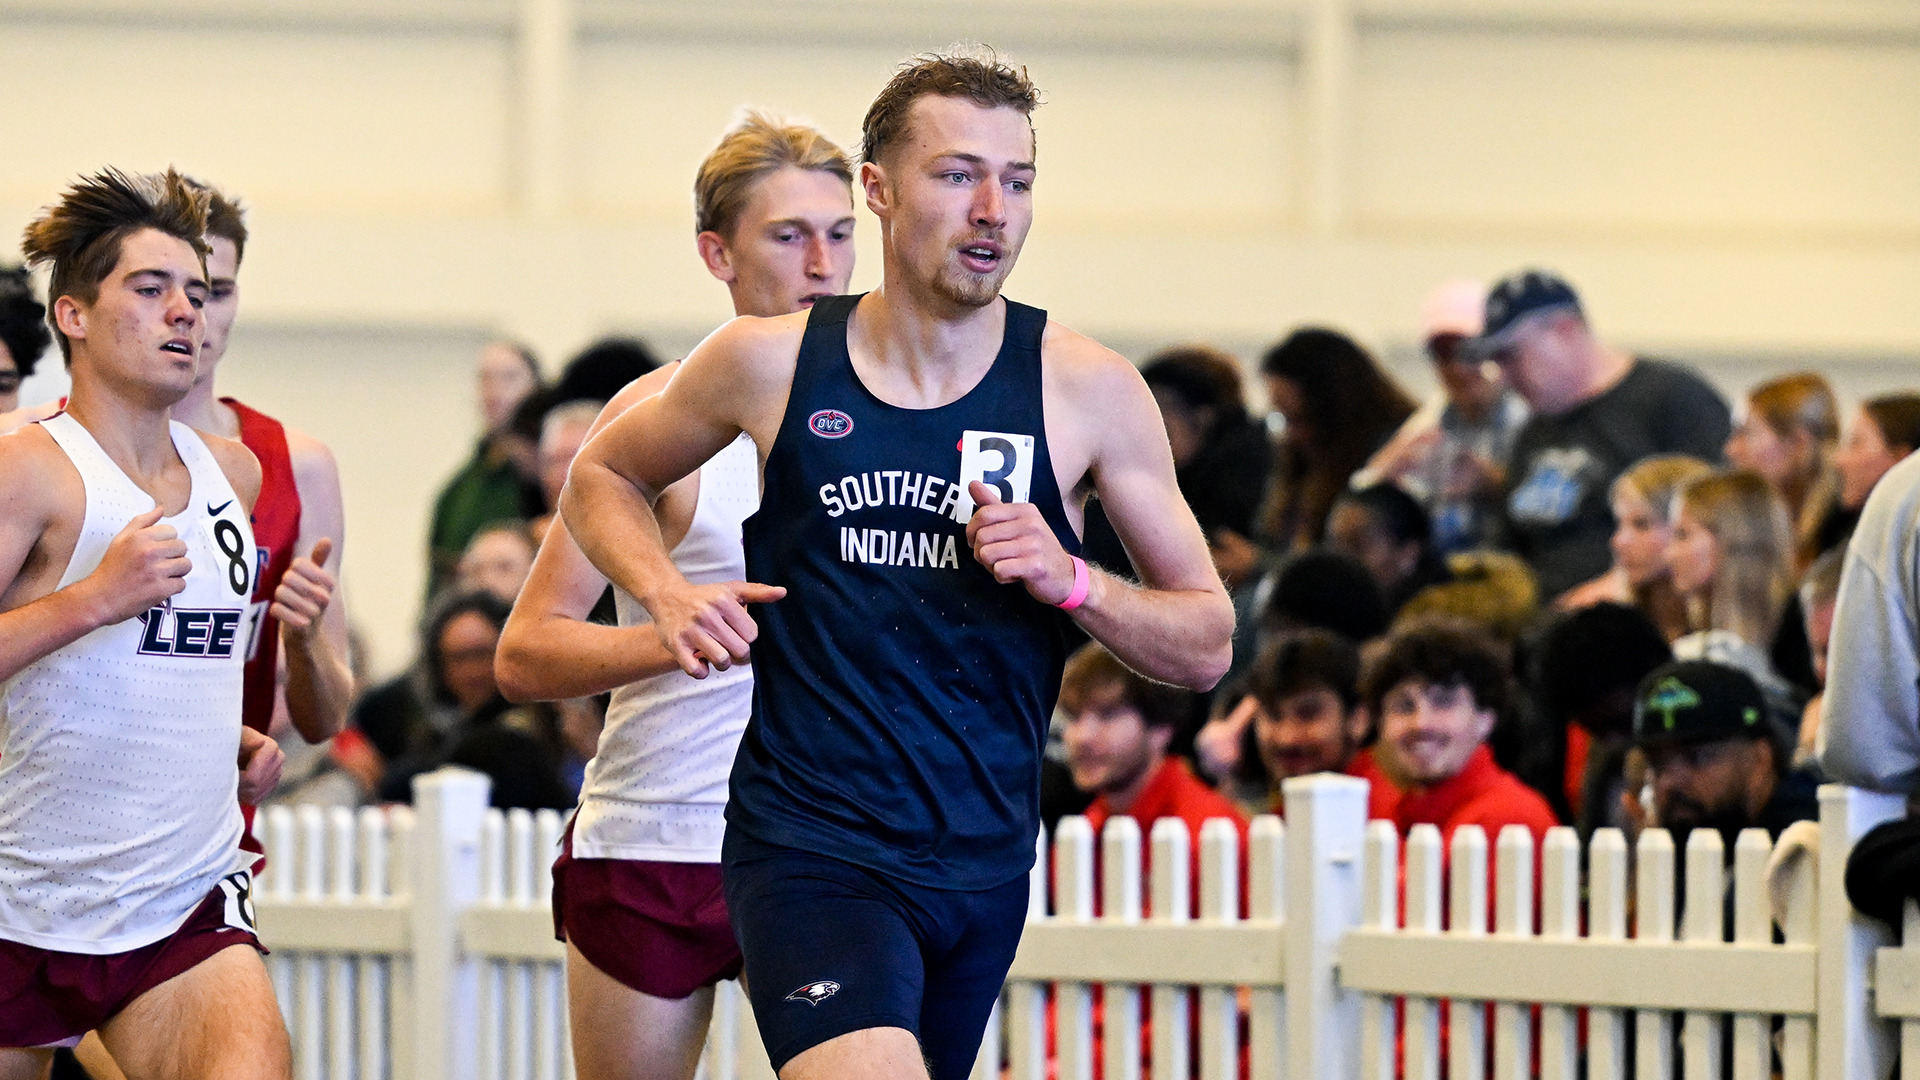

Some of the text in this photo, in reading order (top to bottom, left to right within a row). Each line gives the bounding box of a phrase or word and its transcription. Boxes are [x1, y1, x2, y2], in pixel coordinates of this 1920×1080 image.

[817, 418, 845, 431] OVC
[819, 471, 961, 520] SOUTHER
[979, 437, 1017, 504] 3
[214, 519, 249, 596] 8
[840, 527, 959, 569] INDIANA
[137, 606, 243, 659] LEE
